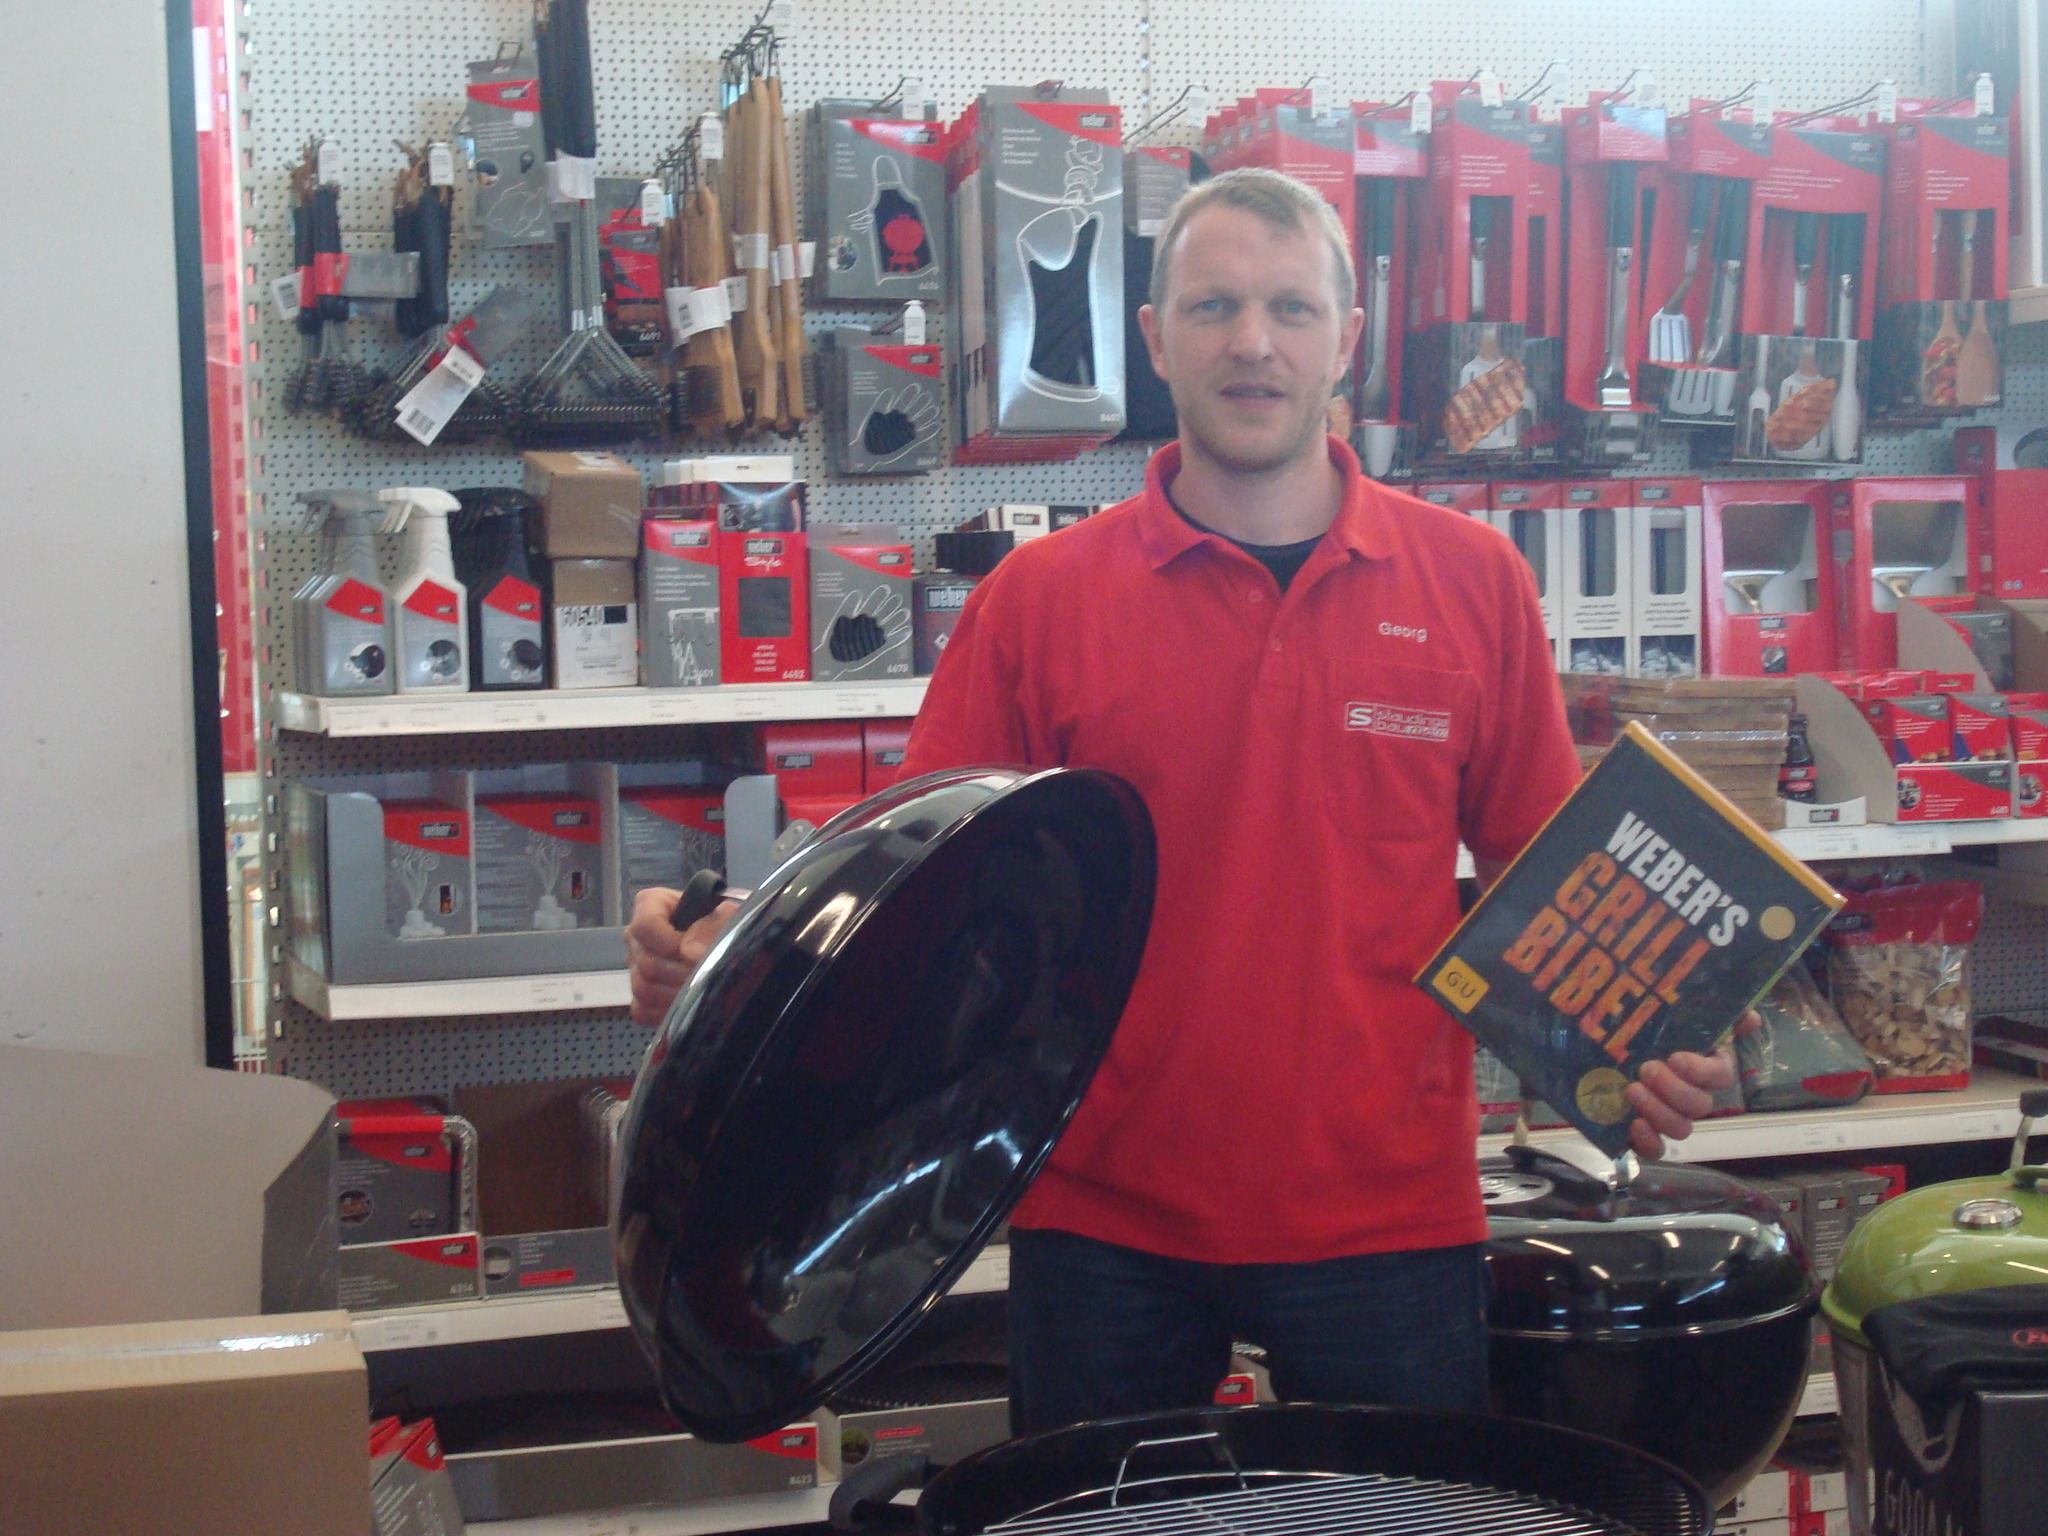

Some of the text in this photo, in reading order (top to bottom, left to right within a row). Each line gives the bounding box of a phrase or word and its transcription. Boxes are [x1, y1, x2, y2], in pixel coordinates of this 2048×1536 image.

[749, 539, 774, 554] weber
[1378, 621, 1428, 643] Georg
[1348, 707, 1374, 726] S
[423, 823, 450, 838] weber
[1605, 811, 1750, 948] WEBER'S
[1555, 852, 1712, 1005] GRILL
[1502, 905, 1662, 1064] BIBEL
